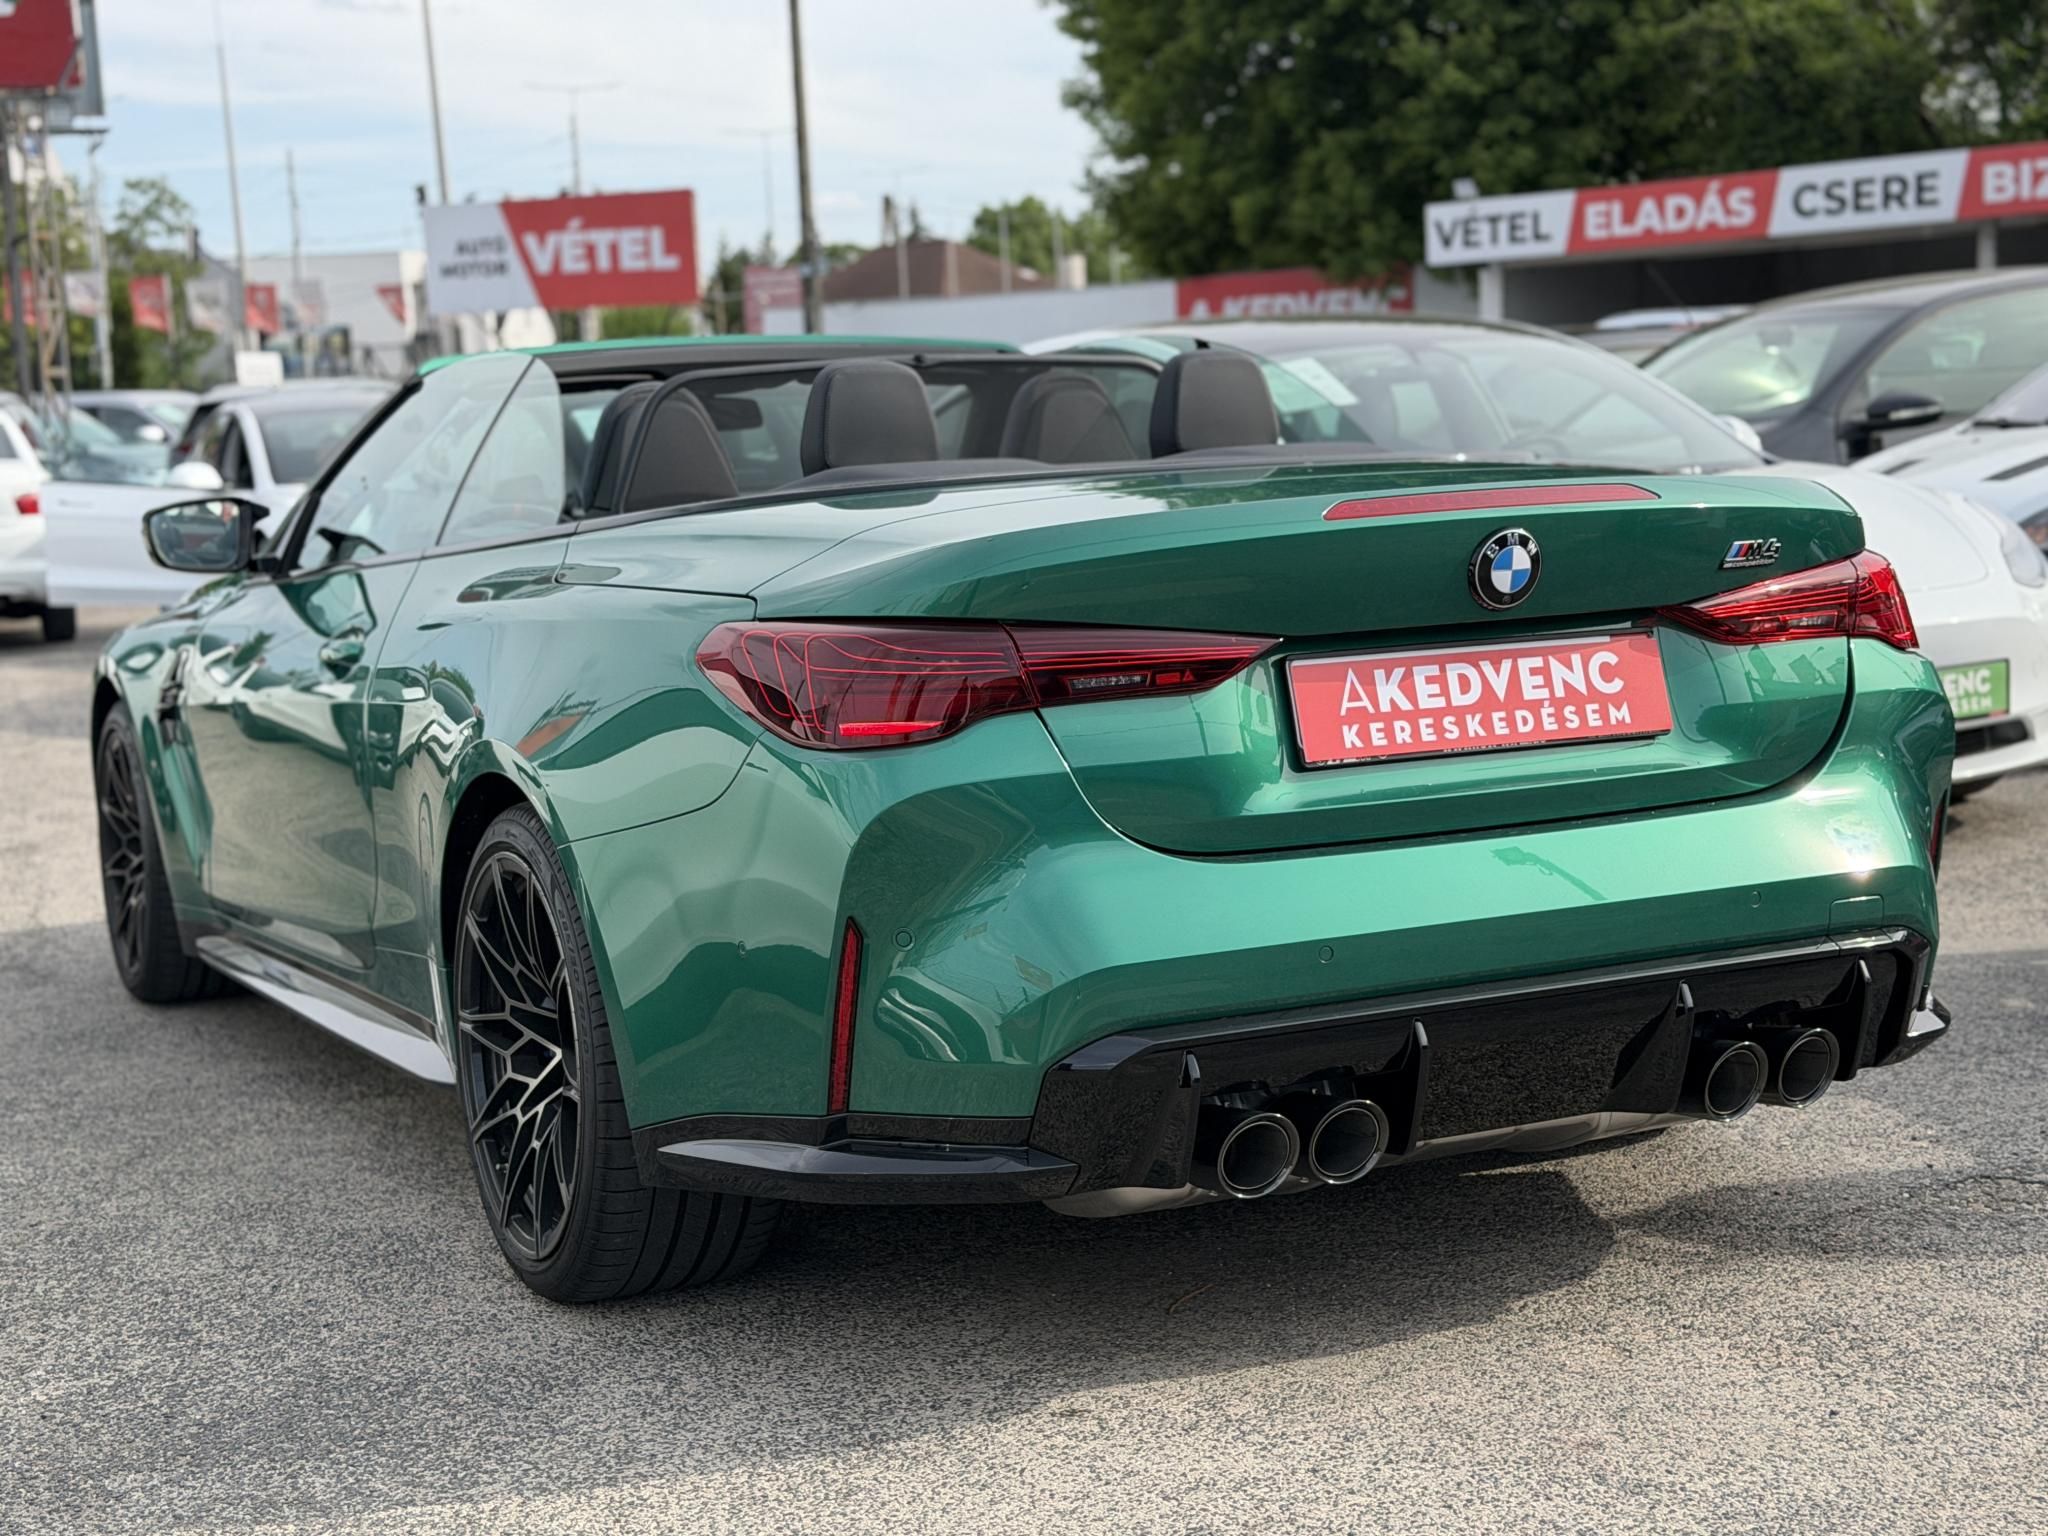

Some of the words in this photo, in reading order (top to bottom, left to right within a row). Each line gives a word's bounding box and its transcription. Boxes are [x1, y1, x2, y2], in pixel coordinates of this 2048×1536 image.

[1435, 205, 1551, 248] VÉTEL
[1584, 181, 1756, 240] ELADÁS
[1793, 170, 1939, 217] CSERE
[523, 218, 680, 274] VÉTEL
[1486, 532, 1538, 560] BMW
[1732, 538, 1781, 560] M4
[1342, 700, 1632, 749] KERESKEDÉSEM
